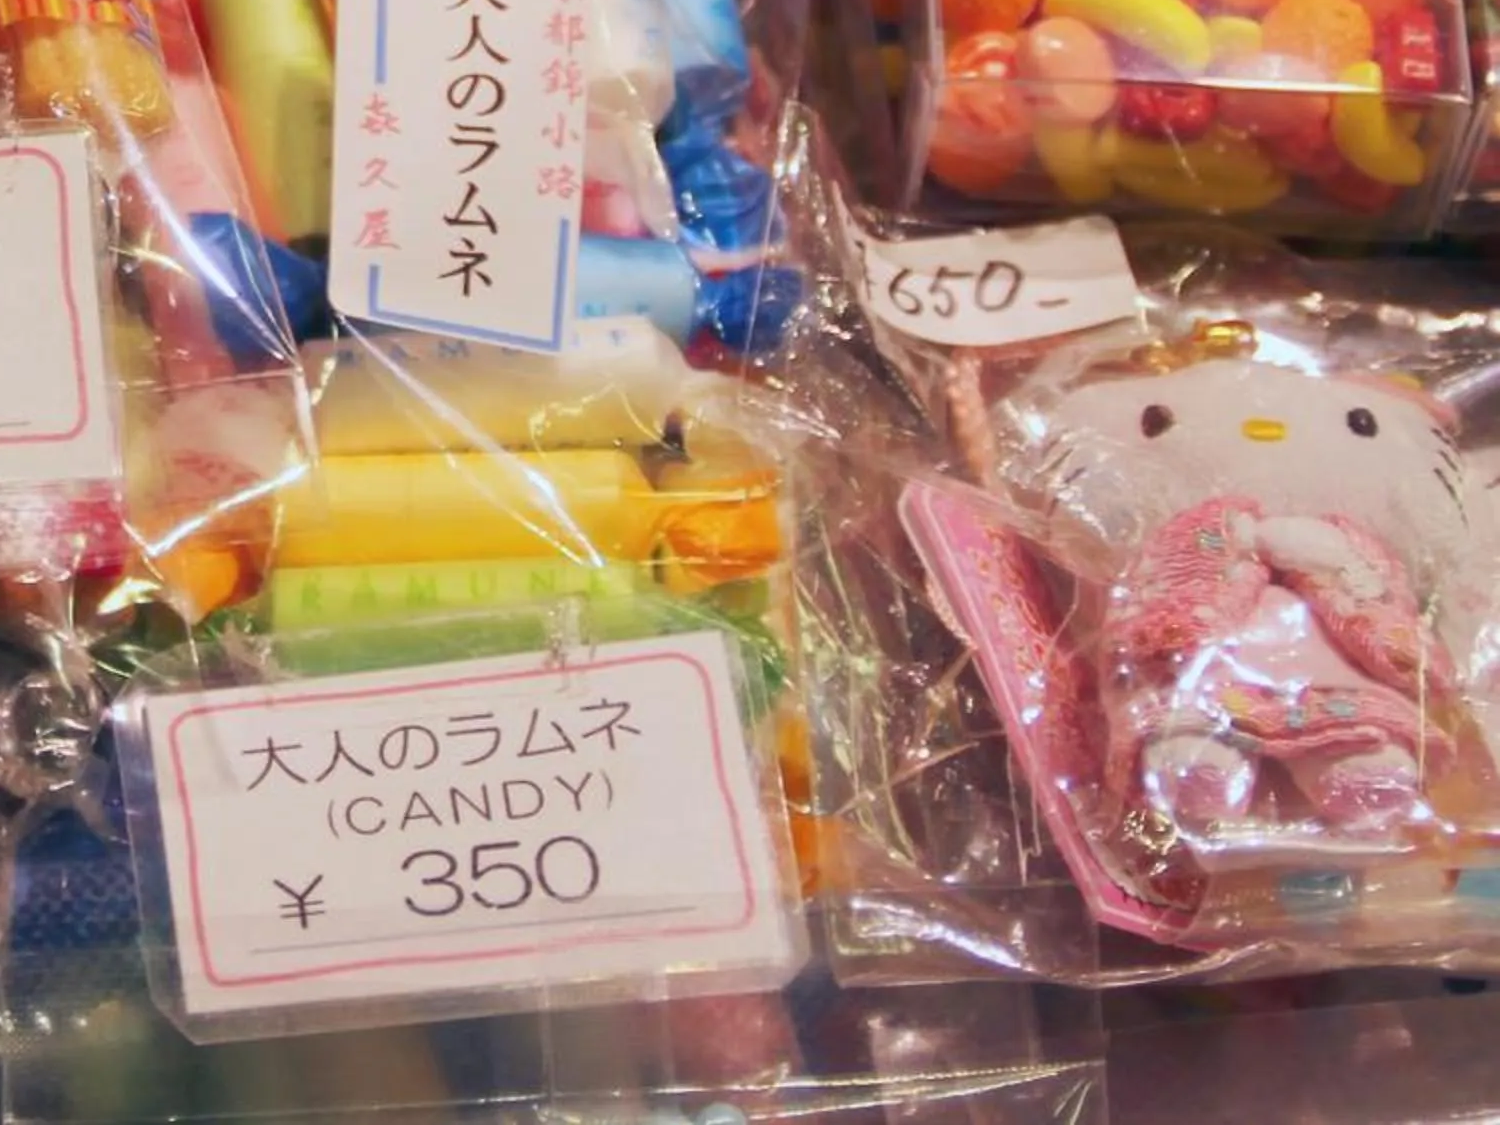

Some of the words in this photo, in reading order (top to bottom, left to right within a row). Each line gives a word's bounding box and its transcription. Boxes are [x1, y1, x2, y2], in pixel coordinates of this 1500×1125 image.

[240, 695, 644, 792] 大人のラムネ
[326, 769, 616, 839] (CANDY)
[271, 873, 326, 931] ¥
[399, 834, 601, 918] 350
